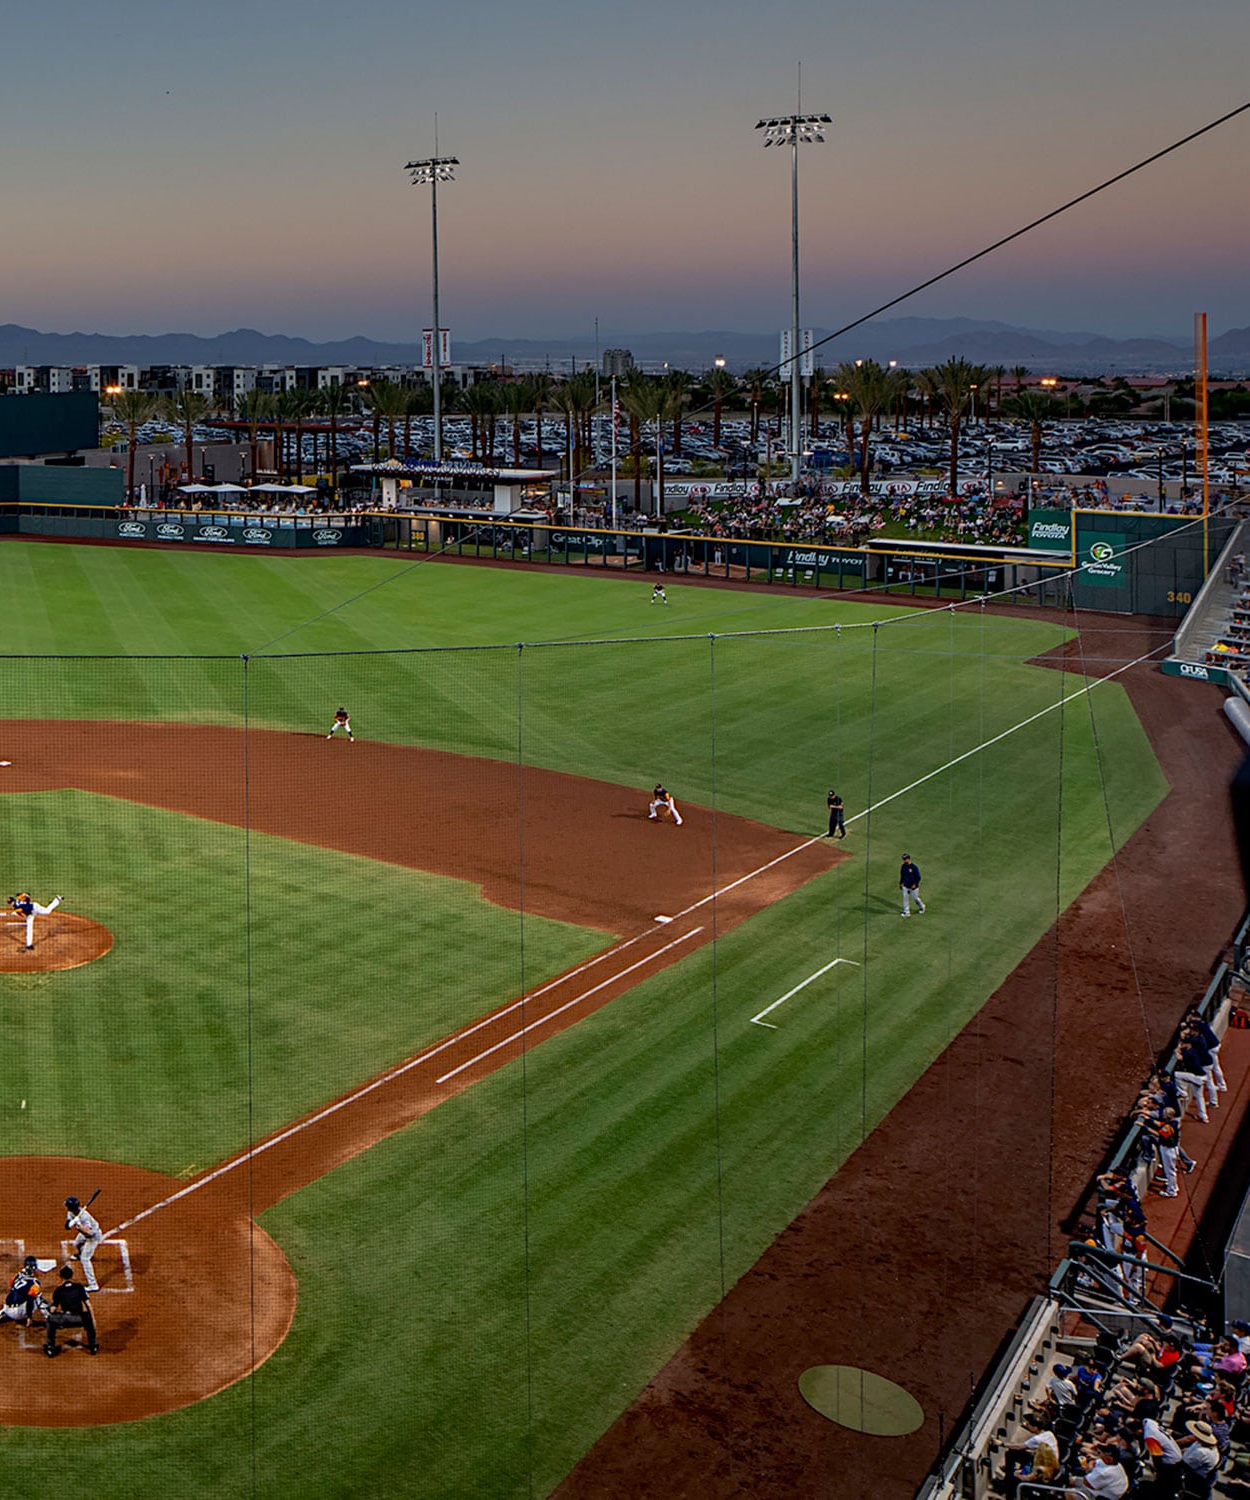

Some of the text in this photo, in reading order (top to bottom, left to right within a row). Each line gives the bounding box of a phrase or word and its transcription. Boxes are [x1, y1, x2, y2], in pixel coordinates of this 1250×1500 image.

[122, 523, 141, 533] Ford
[161, 525, 180, 534] Ford
[204, 527, 223, 537] Ford
[1033, 522, 1070, 535] Findlay
[247, 528, 267, 539] Ford
[317, 529, 337, 540] Ford
[1031, 531, 1066, 540] TOYOTA
[1087, 567, 1116, 577] Grocery
[1167, 591, 1192, 604] 340
